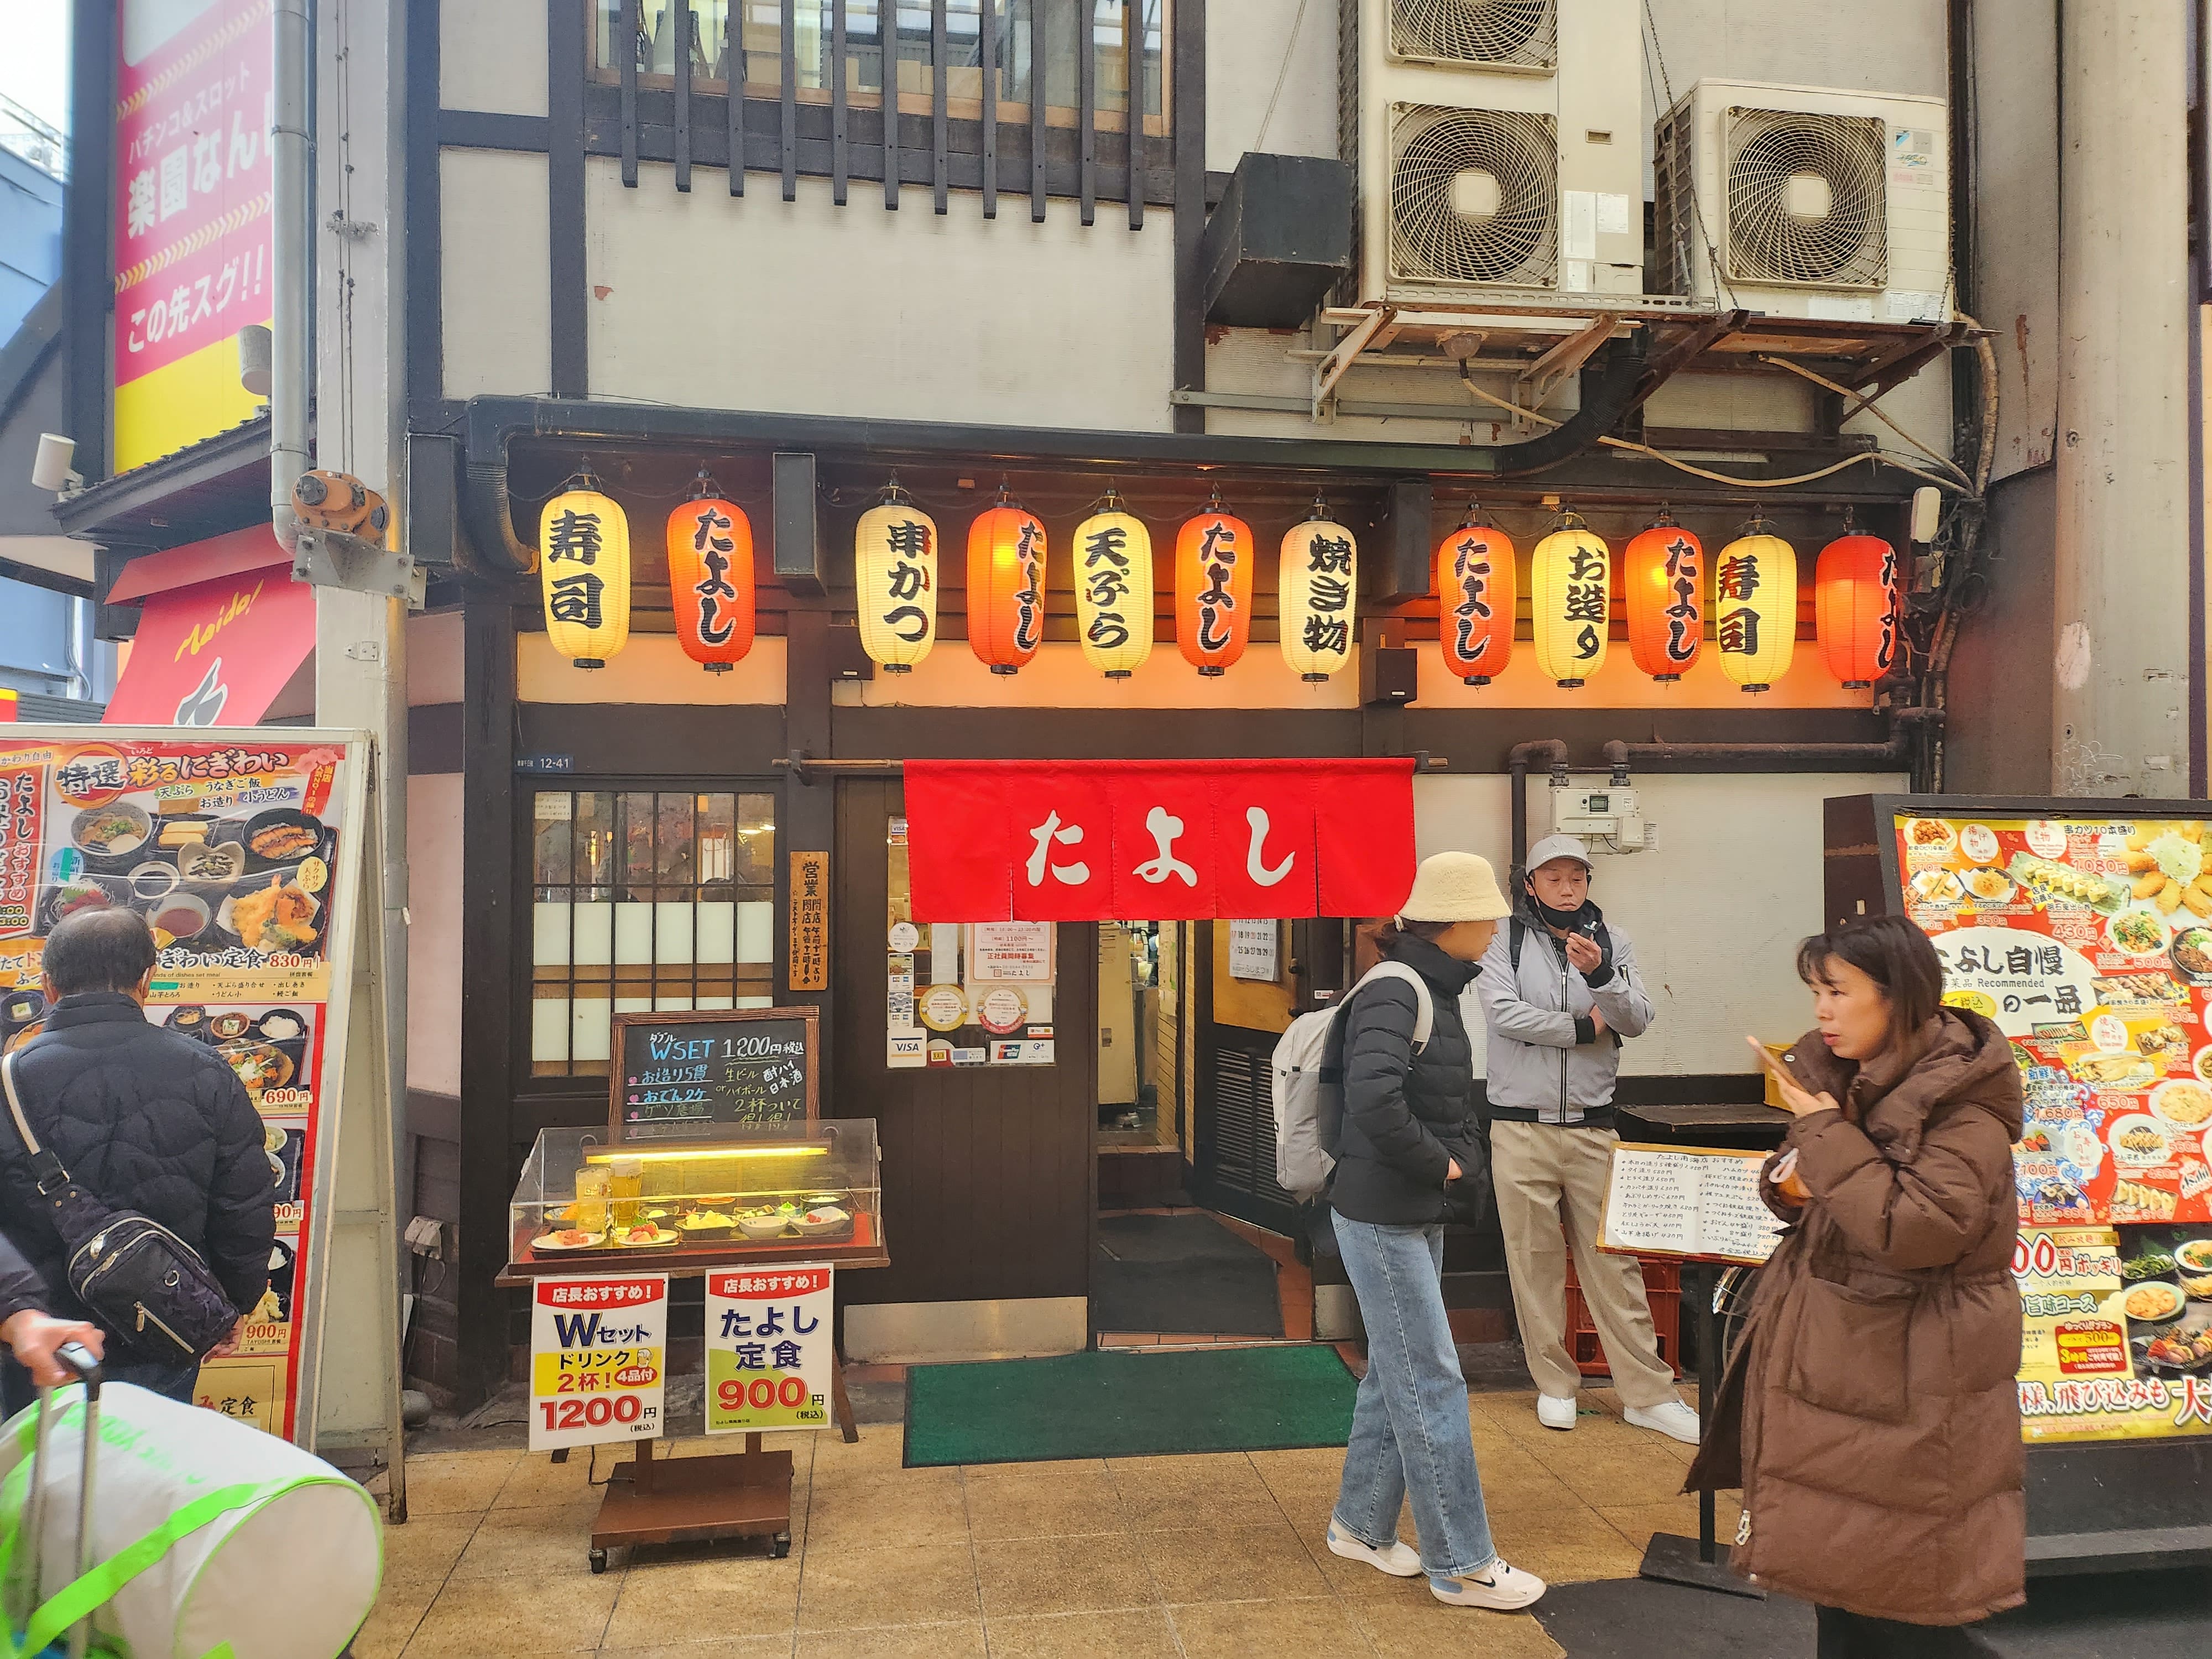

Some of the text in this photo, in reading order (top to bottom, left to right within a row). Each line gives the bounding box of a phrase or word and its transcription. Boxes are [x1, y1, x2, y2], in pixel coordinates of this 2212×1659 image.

[547, 509, 605, 629] 寿司
[695, 508, 735, 645] たよし
[883, 520, 932, 643] 串かつ
[1015, 521, 1045, 651] たよし
[1084, 528, 1130, 649] 天ぷら
[1198, 521, 1236, 651] たよし
[1303, 534, 1352, 655] 焼き物
[1454, 536, 1491, 662] たよし
[1564, 545, 1608, 660] お造り
[1665, 536, 1700, 662] たよし
[1719, 554, 1761, 656] 寿司
[1, 750, 52, 766] かわり自由
[540, 758, 568, 769] 12-41
[56, 760, 126, 794] 特選
[322, 765, 333, 783] 当店
[159, 785, 195, 799] 天ぷら
[205, 778, 262, 792] うなぎご飯
[200, 796, 233, 808] お造り
[243, 788, 290, 804] 小うどん
[1026, 805, 1296, 888] たよし
[802, 860, 820, 897] 営業
[2052, 925, 2098, 940] 430円
[157, 947, 312, 968] ぎわい定食 830円
[2135, 956, 2172, 969] 500円
[1978, 978, 2045, 988] Recommended
[2003, 984, 2083, 1015] の一品
[895, 1043, 919, 1051] VISA
[265, 1089, 309, 1104] 690円
[2098, 1095, 2138, 1109] 650円
[273, 1206, 301, 1218] 90円
[552, 1285, 652, 1303] 店長おすすめ!
[723, 1275, 818, 1294] 店長おすすめ!
[246, 1324, 286, 1339] 900円
[553, 1312, 651, 1349] Wセット
[720, 1306, 819, 1339] たよし
[559, 1350, 630, 1370] ドリンク
[735, 1340, 803, 1372] 定食
[617, 1369, 655, 1384] 4品付
[717, 1377, 825, 1412] 900円
[540, 1395, 657, 1432] 1200円
[796, 1410, 824, 1421] (税込)
[630, 1422, 655, 1433] (税込)
